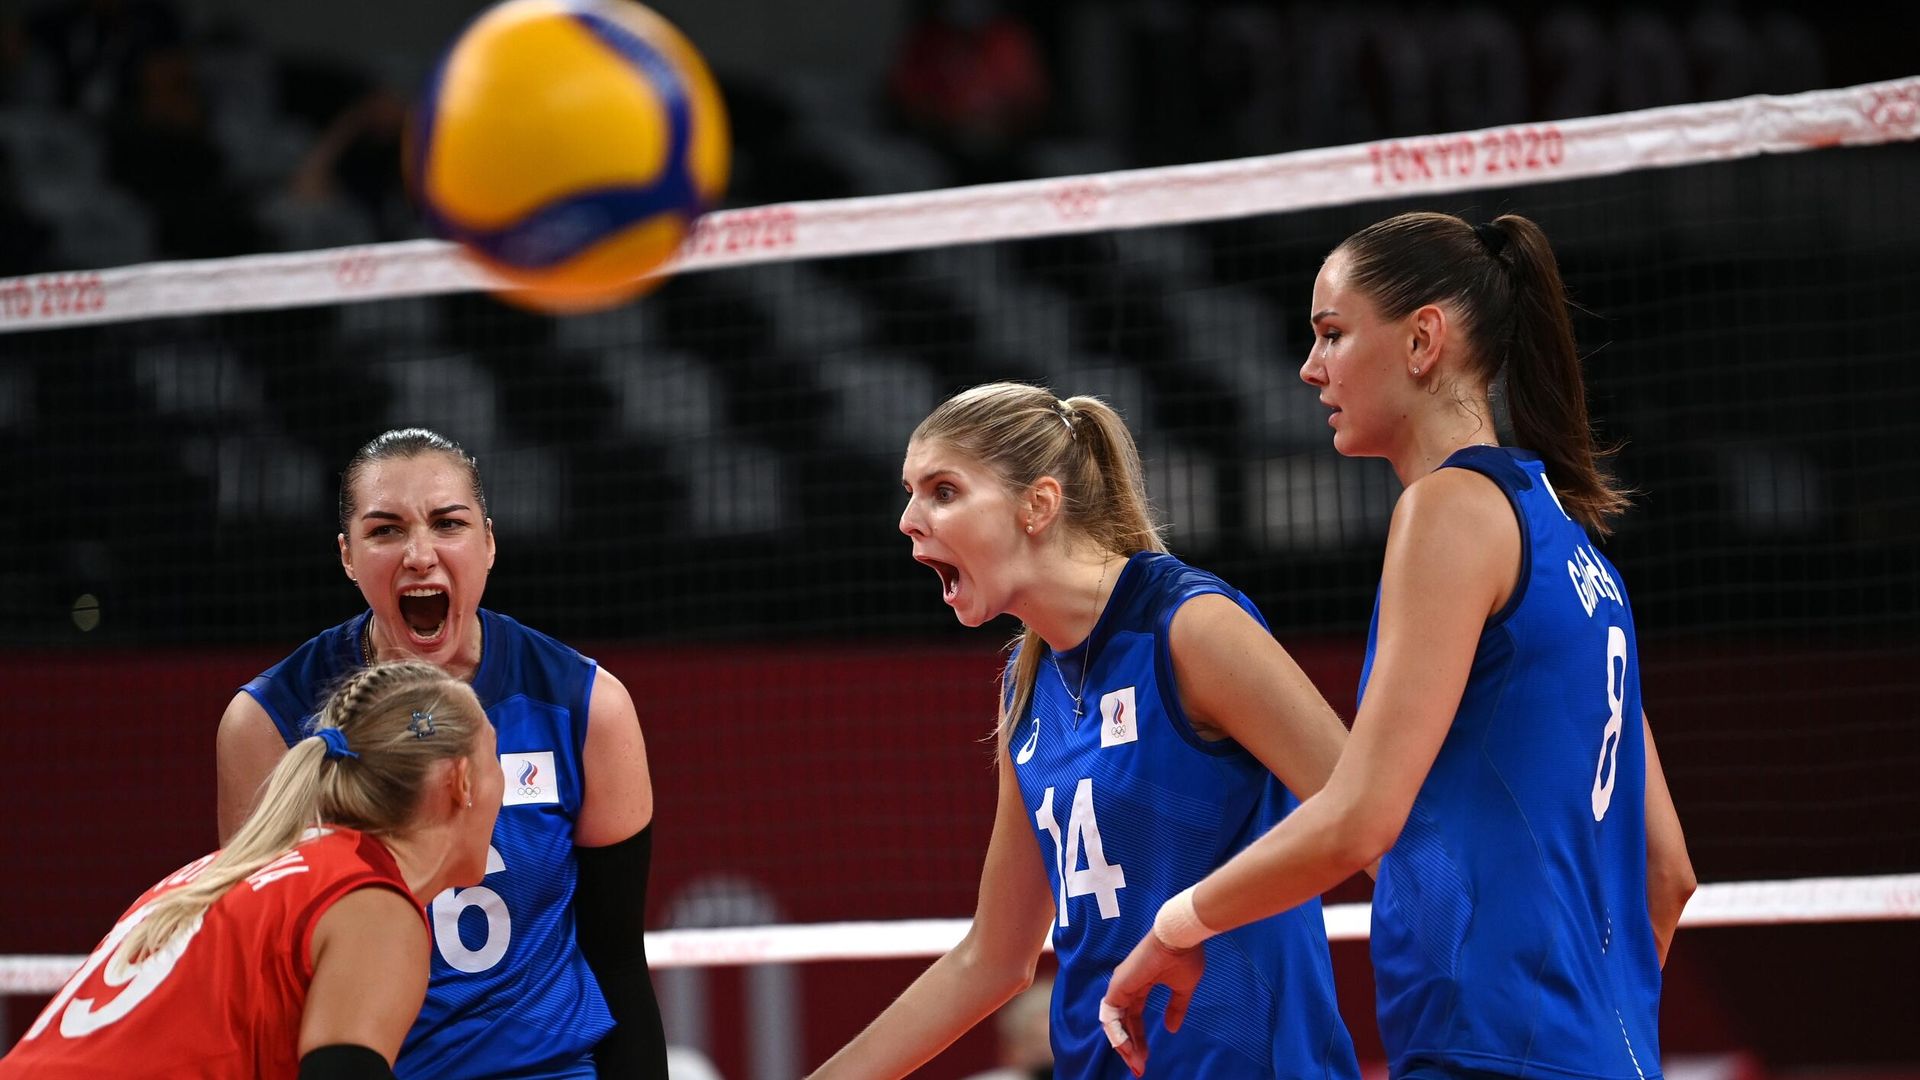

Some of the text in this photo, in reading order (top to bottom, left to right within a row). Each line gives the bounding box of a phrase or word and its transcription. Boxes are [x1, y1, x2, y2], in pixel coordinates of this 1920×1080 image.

[1368, 124, 1564, 184] TOKYO 2020
[723, 206, 796, 252] 2020
[1592, 626, 1627, 821] 8
[1035, 778, 1126, 927] 14
[22, 900, 206, 1040] 19
